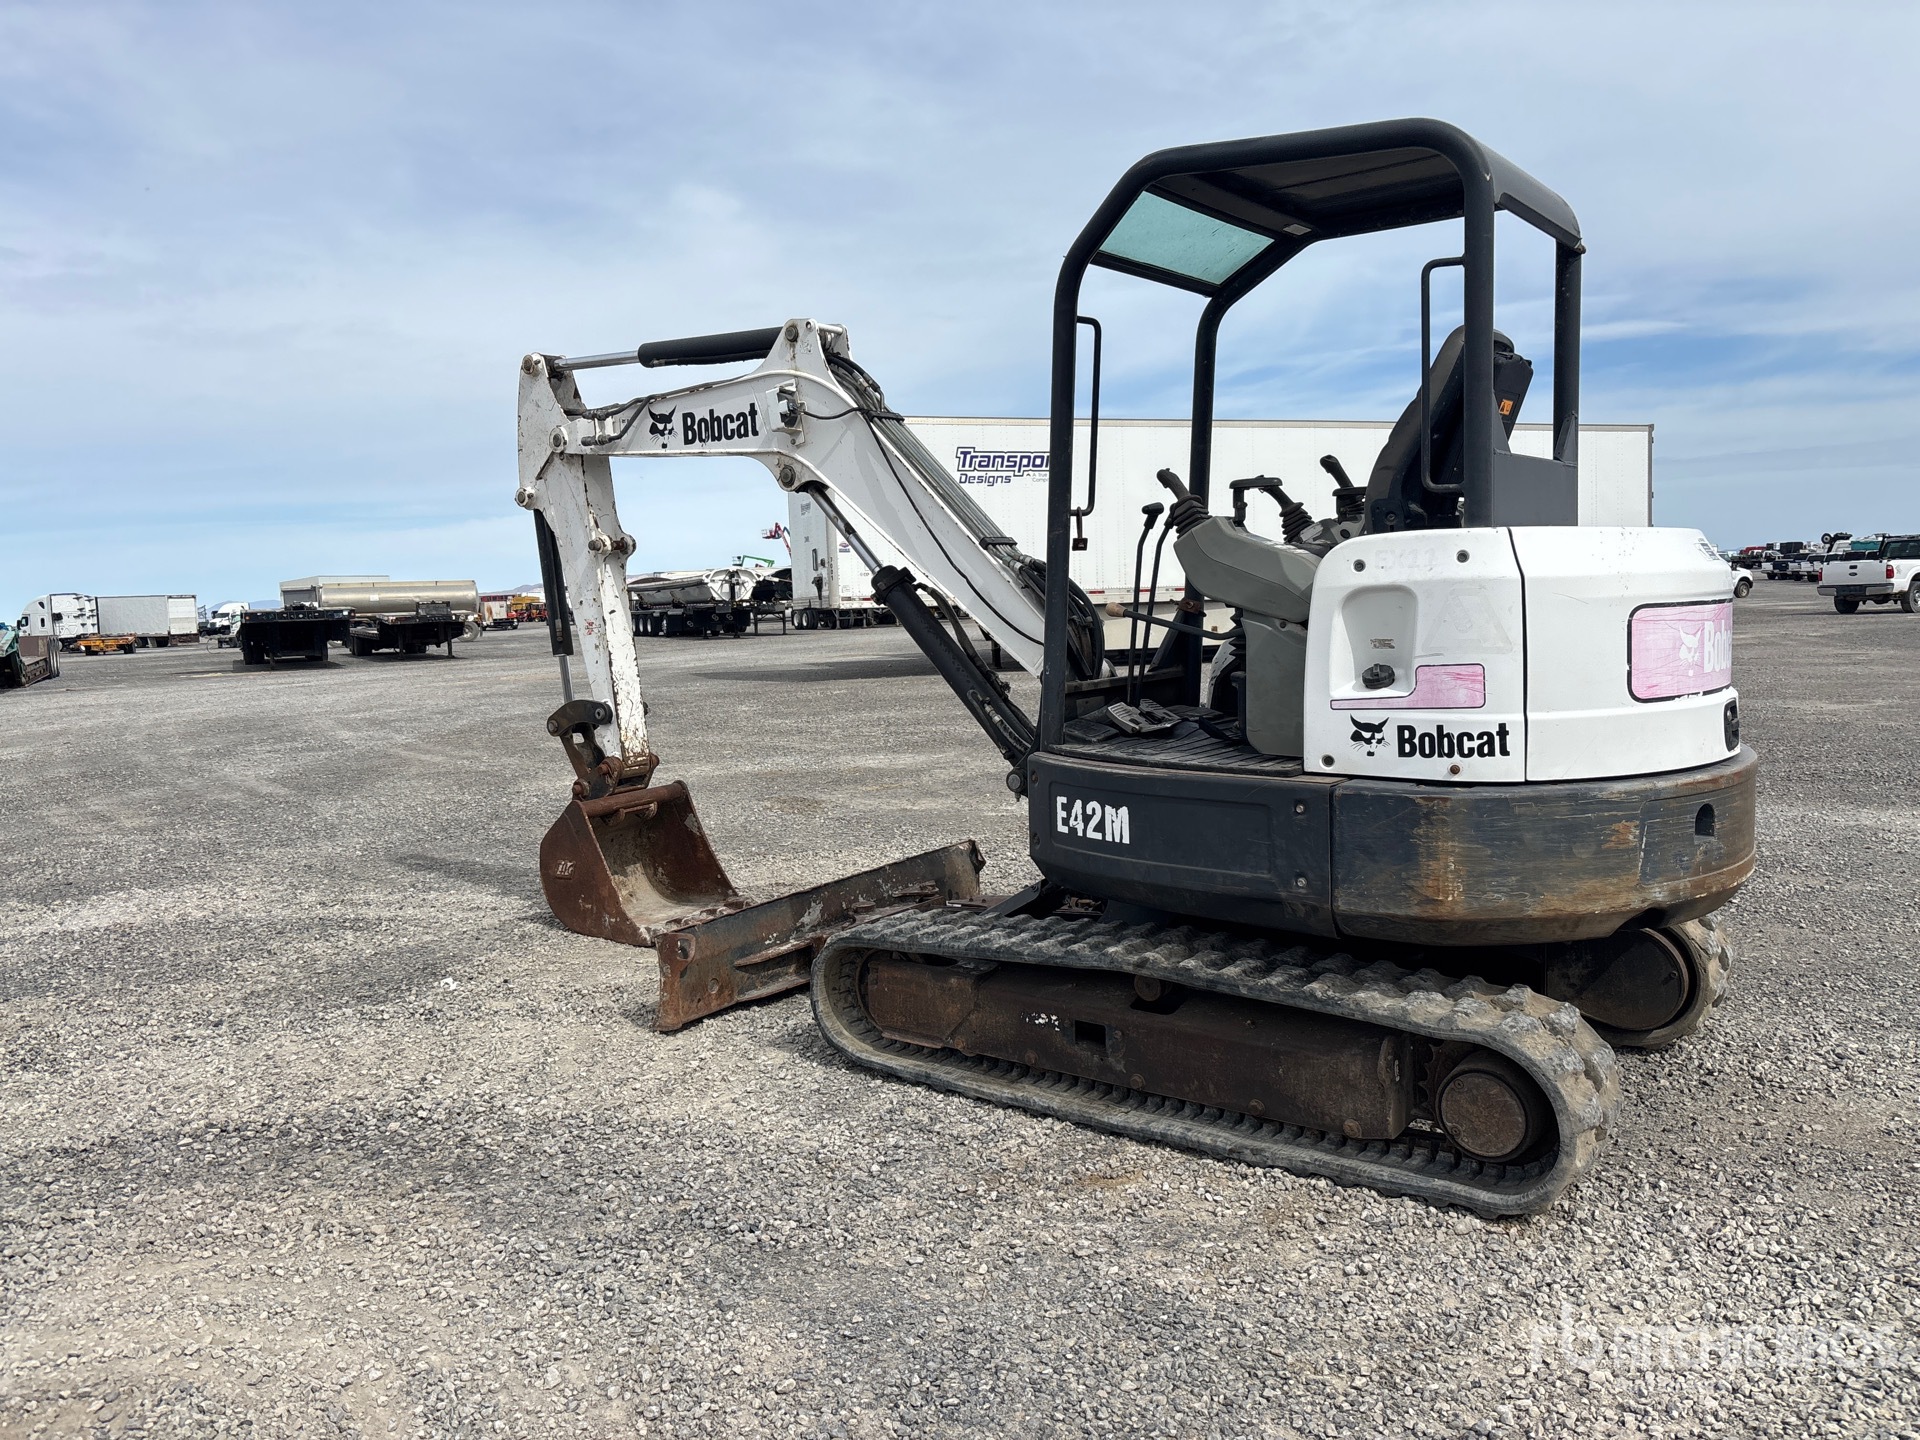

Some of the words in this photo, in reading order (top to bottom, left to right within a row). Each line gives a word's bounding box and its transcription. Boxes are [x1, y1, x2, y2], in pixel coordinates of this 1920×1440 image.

[682, 402, 759, 446] Bobcat
[959, 472, 1012, 487] Designs
[1397, 722, 1510, 759] Bobcat
[1056, 795, 1130, 844] E42M
